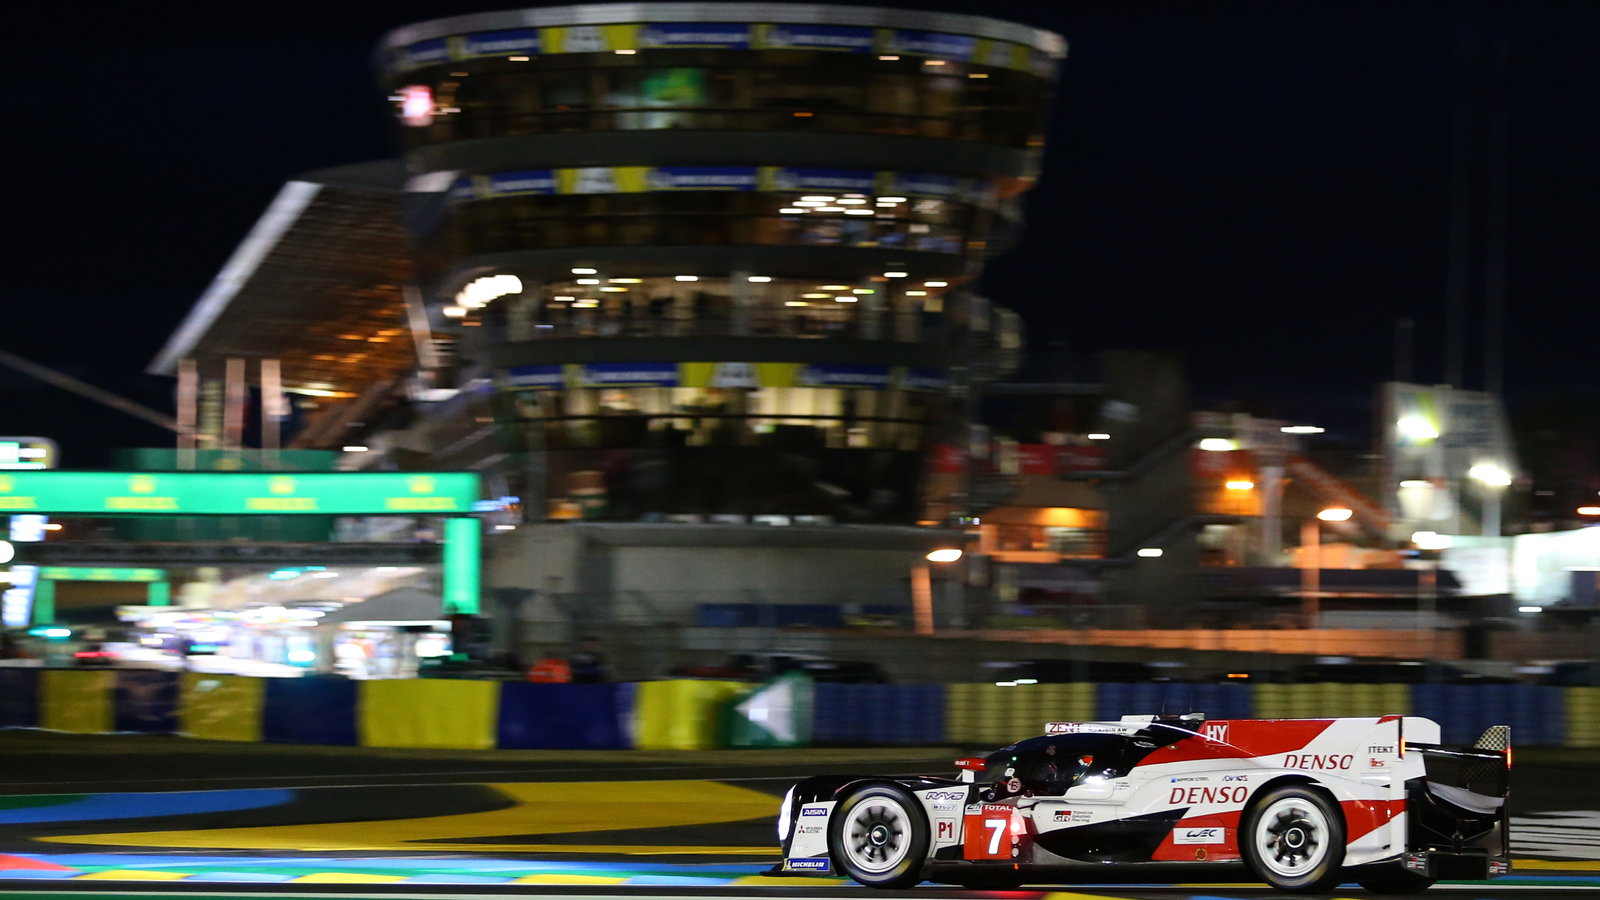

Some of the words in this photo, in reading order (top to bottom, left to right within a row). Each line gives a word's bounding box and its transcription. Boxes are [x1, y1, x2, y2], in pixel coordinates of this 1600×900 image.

[1049, 722, 1083, 733] ZENT
[1207, 725, 1229, 742] HY
[1368, 745, 1394, 754] JTEKT
[1283, 754, 1354, 770] DENSO
[926, 791, 965, 800] RAYS
[1169, 786, 1248, 805] DENSO
[1053, 814, 1072, 823] GR
[938, 822, 953, 839] P1
[985, 819, 1007, 855] 7
[1186, 829, 1218, 838] WEC
